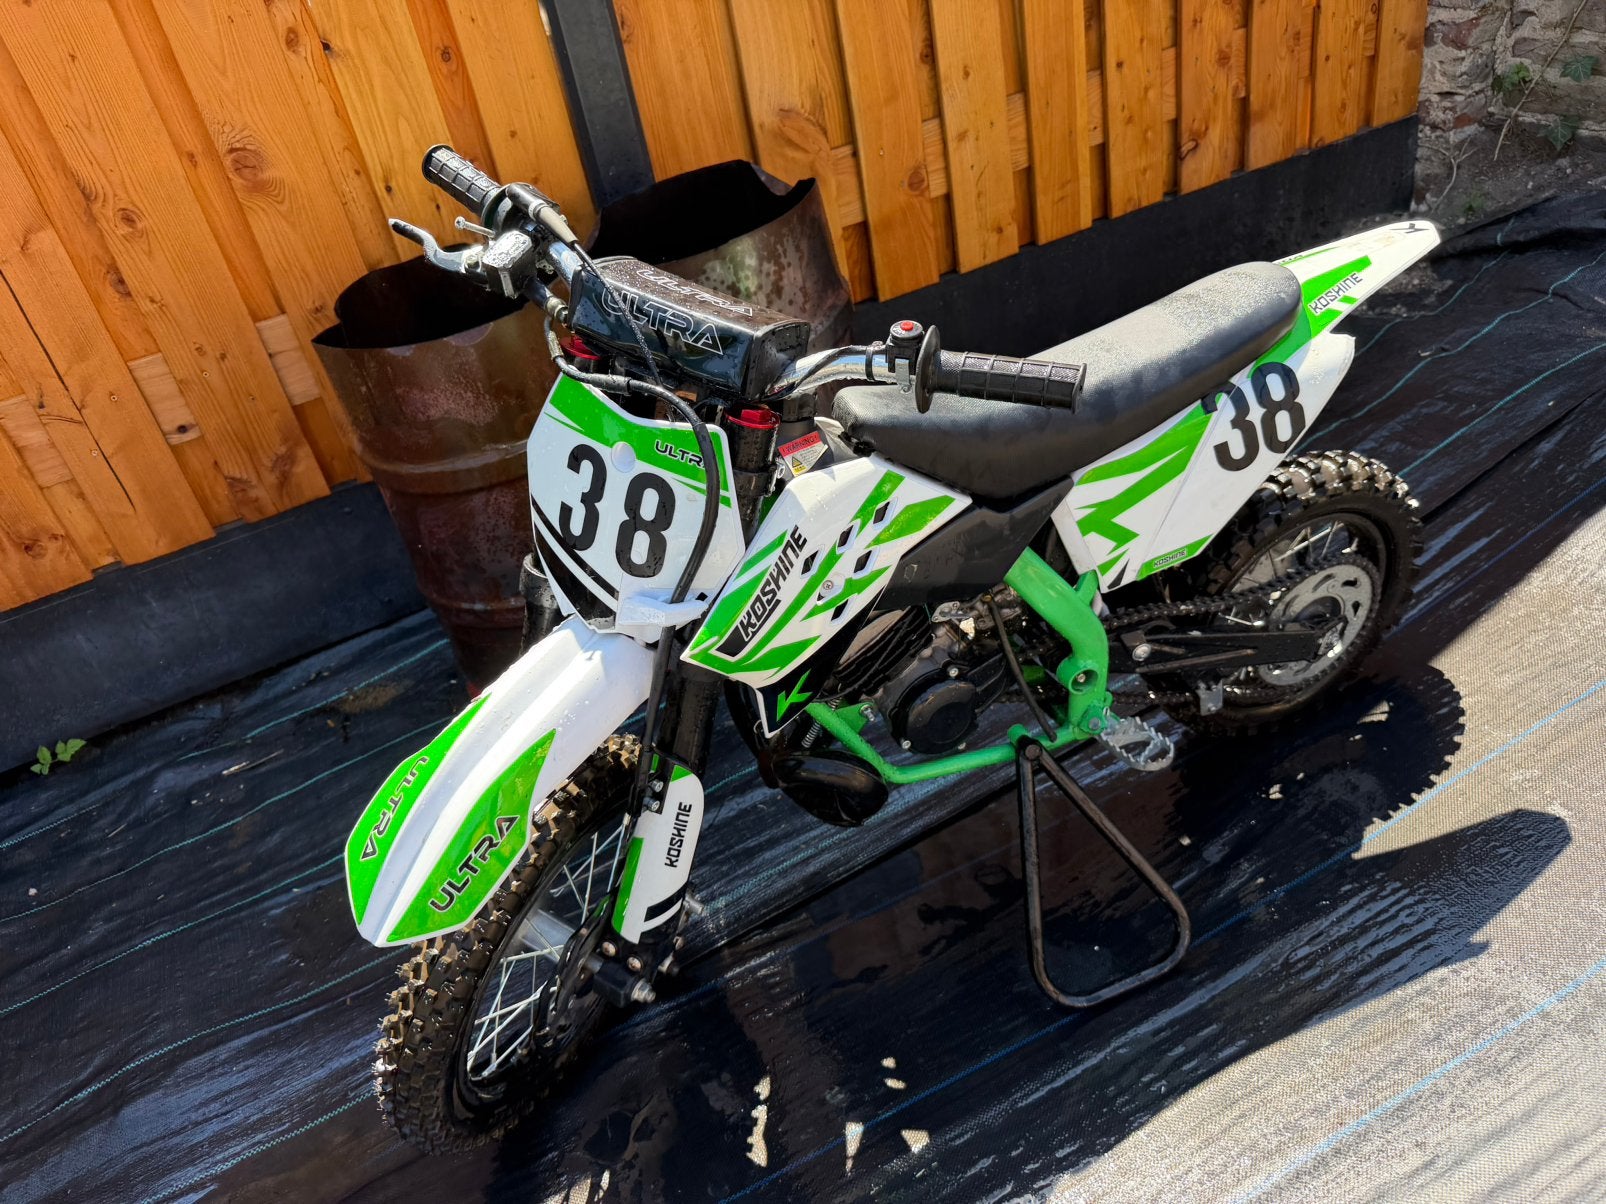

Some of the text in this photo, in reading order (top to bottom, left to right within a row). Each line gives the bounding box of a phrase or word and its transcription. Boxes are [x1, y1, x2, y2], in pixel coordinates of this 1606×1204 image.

[601, 287, 723, 355] ULTRA
[636, 269, 752, 316] ULTRA
[1308, 272, 1363, 314] KOSHINE
[1200, 361, 1306, 472] 38
[655, 439, 706, 468] ULTR
[558, 443, 676, 578] 38
[738, 525, 808, 642] KOSHINE
[1153, 549, 1186, 567] KOSHINE
[360, 755, 428, 861] ULTRA
[664, 801, 692, 868] KOSHINE
[428, 814, 520, 913] ULTRA
